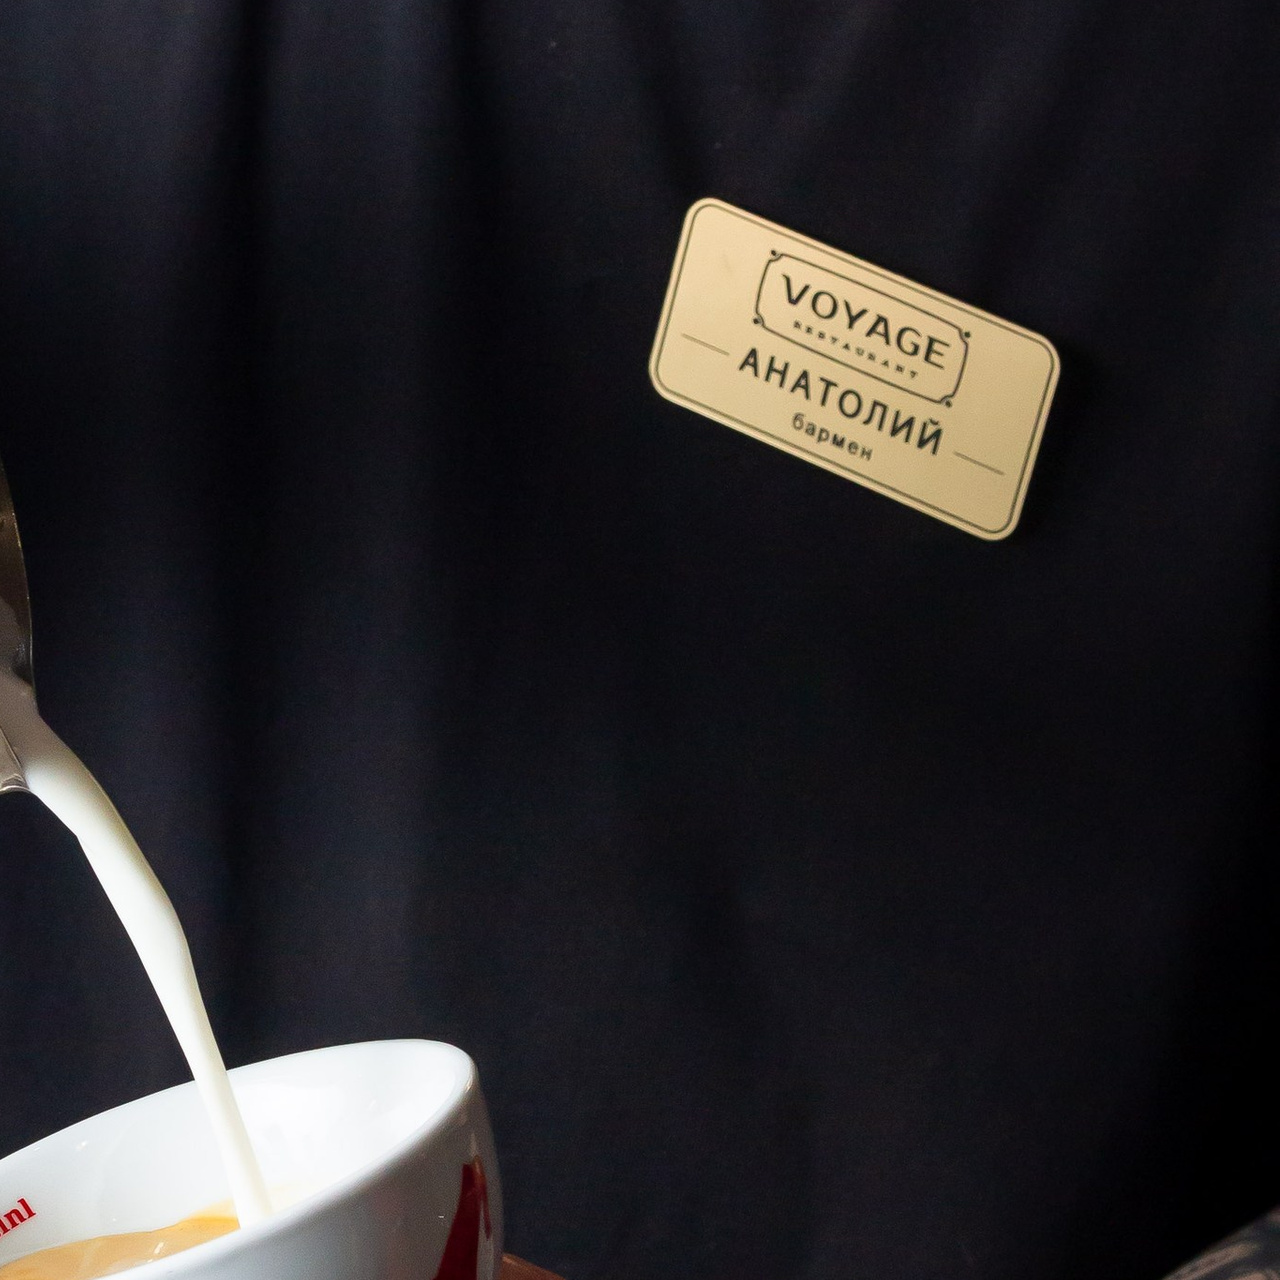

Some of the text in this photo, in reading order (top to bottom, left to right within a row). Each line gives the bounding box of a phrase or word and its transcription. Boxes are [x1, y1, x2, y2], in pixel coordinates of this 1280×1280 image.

[782, 273, 951, 370] VOYAGE
[793, 319, 919, 380] RESTAURANT
[738, 347, 945, 457] АНАТОЛИЙ
[792, 412, 874, 462] бармен
